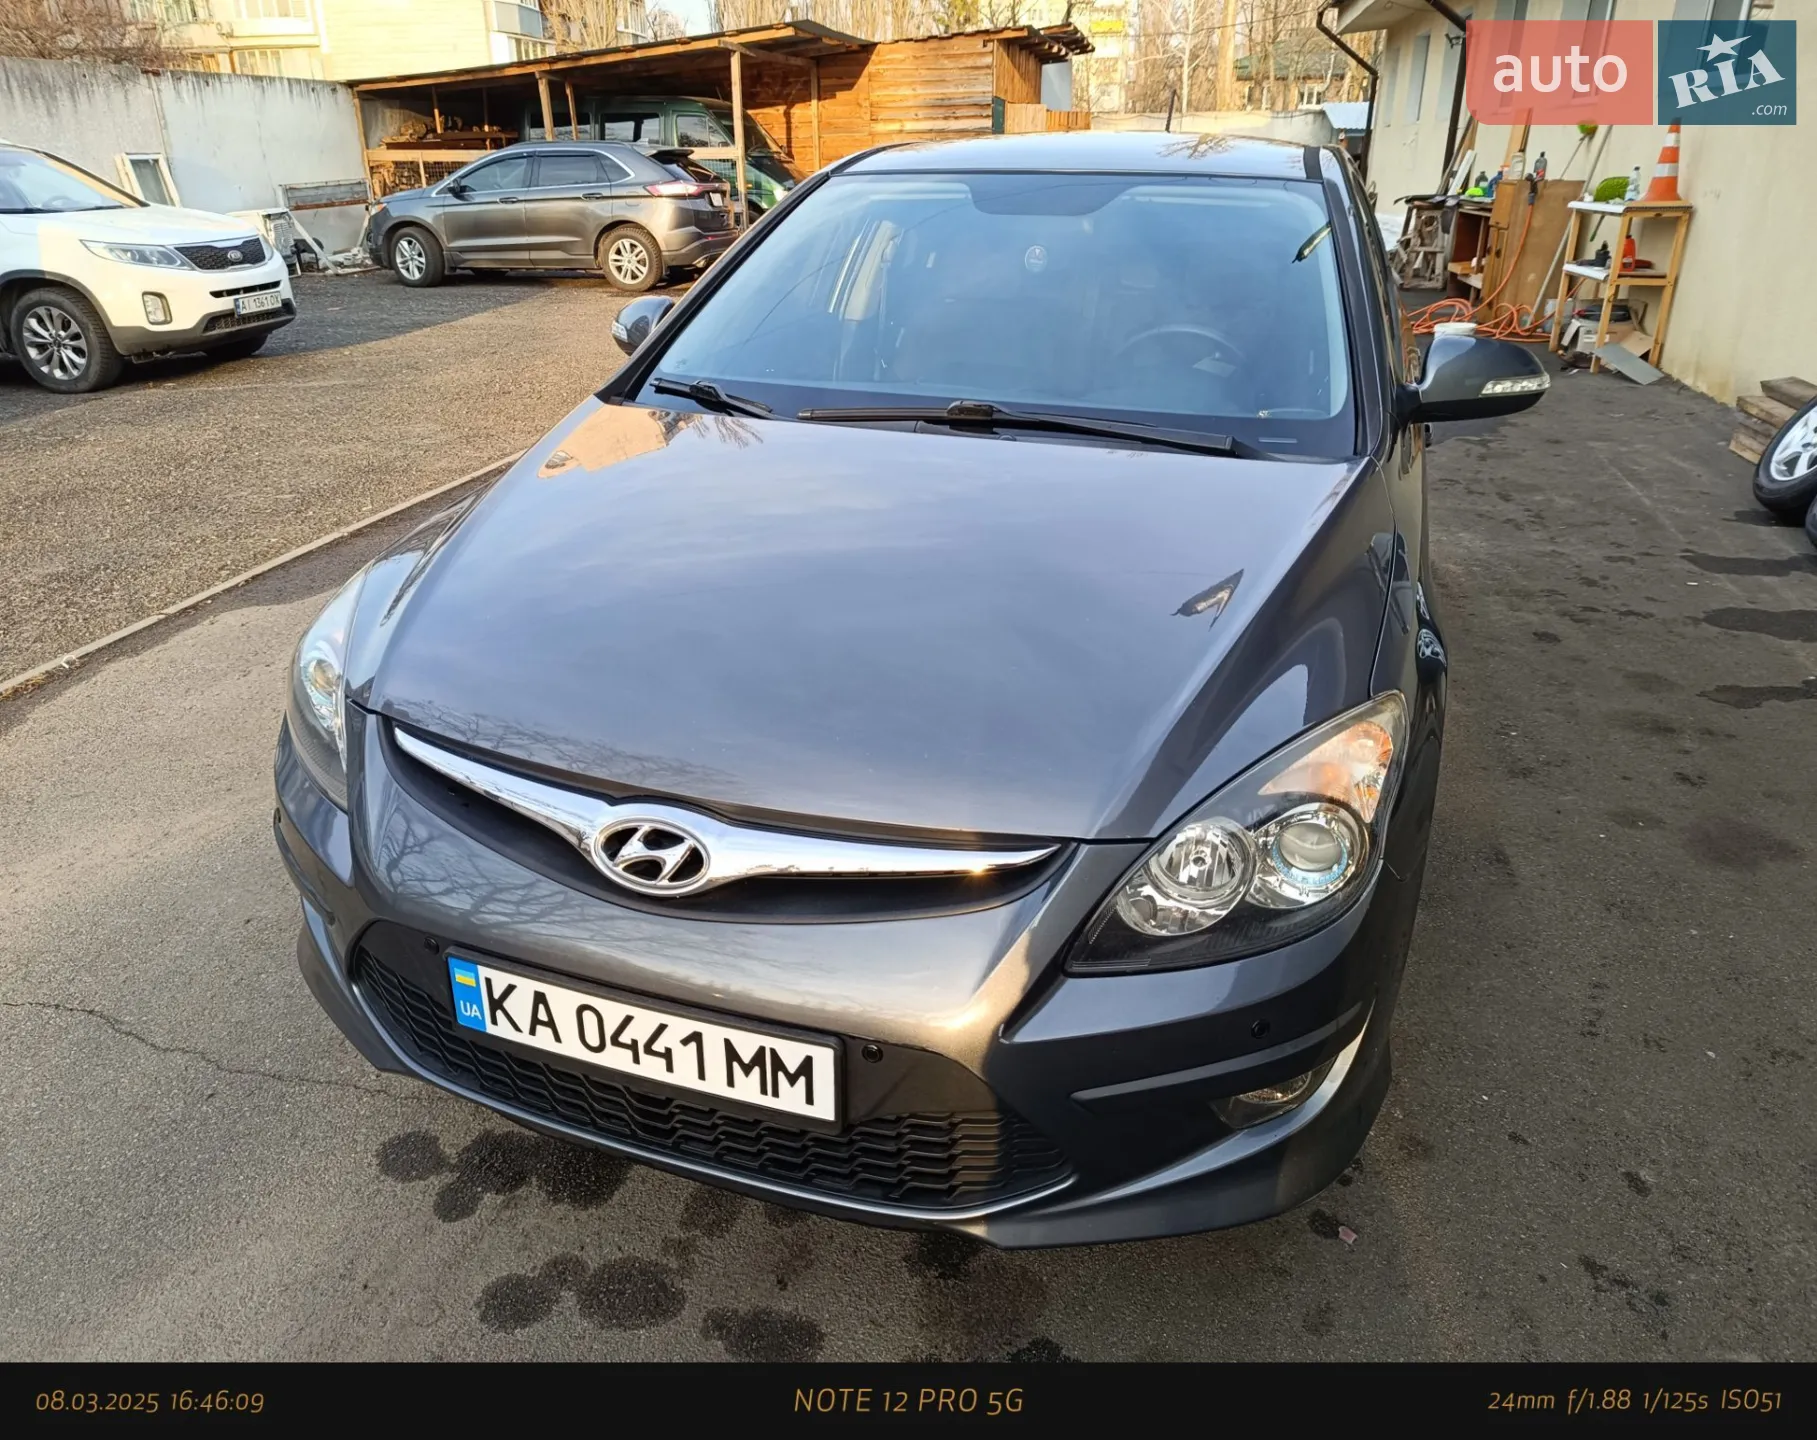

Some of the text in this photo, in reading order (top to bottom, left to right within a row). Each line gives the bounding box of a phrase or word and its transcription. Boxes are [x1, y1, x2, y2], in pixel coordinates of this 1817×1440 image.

[460, 1000, 483, 1020] UA
[484, 976, 814, 1106] KA 0441 MM
